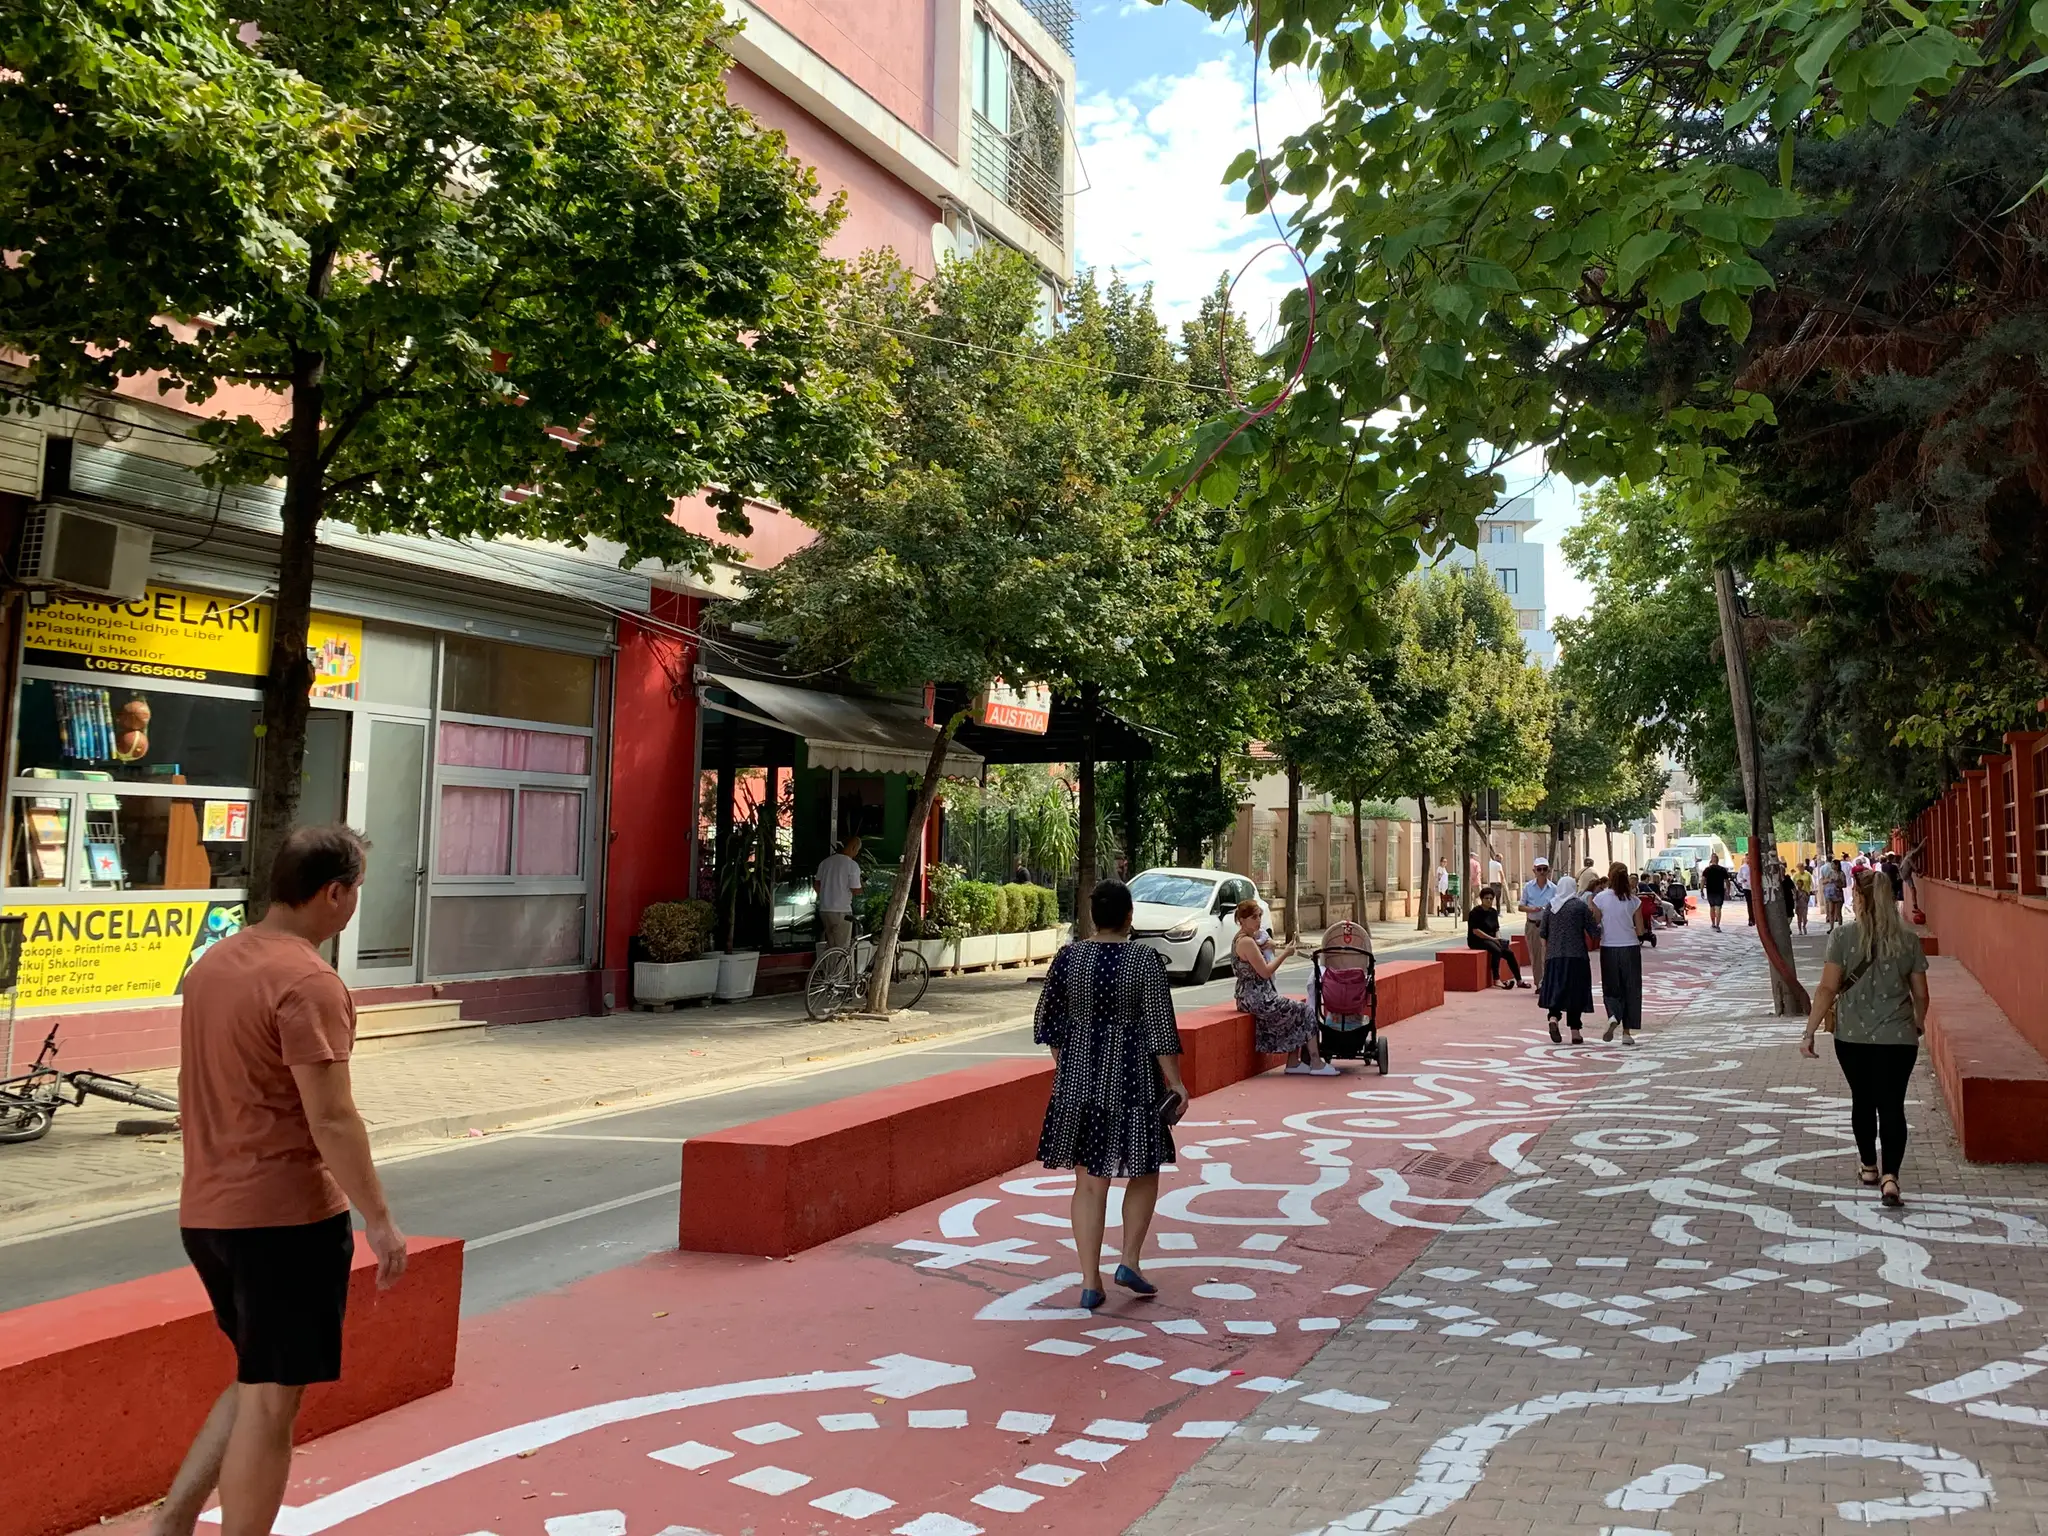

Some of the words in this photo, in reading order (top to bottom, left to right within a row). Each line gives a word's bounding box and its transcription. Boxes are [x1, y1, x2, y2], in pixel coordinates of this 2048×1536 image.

[48, 592, 260, 634] CELARI
[36, 621, 137, 643] Plastifikime
[34, 635, 93, 653] Artikuj
[98, 643, 166, 660] shkollor
[95, 659, 207, 681] 0675656045
[989, 706, 1044, 730] AUSTRIA
[74, 942, 121, 954] Printime
[124, 942, 138, 952] A3
[148, 942, 162, 951] A4
[48, 958, 100, 969] Shkollore
[36, 986, 57, 997] dhe
[61, 984, 102, 995] Revista
[105, 983, 124, 994] per
[127, 980, 161, 991] Femije
[47, 974, 66, 985] per
[69, 972, 95, 983] Zyra
